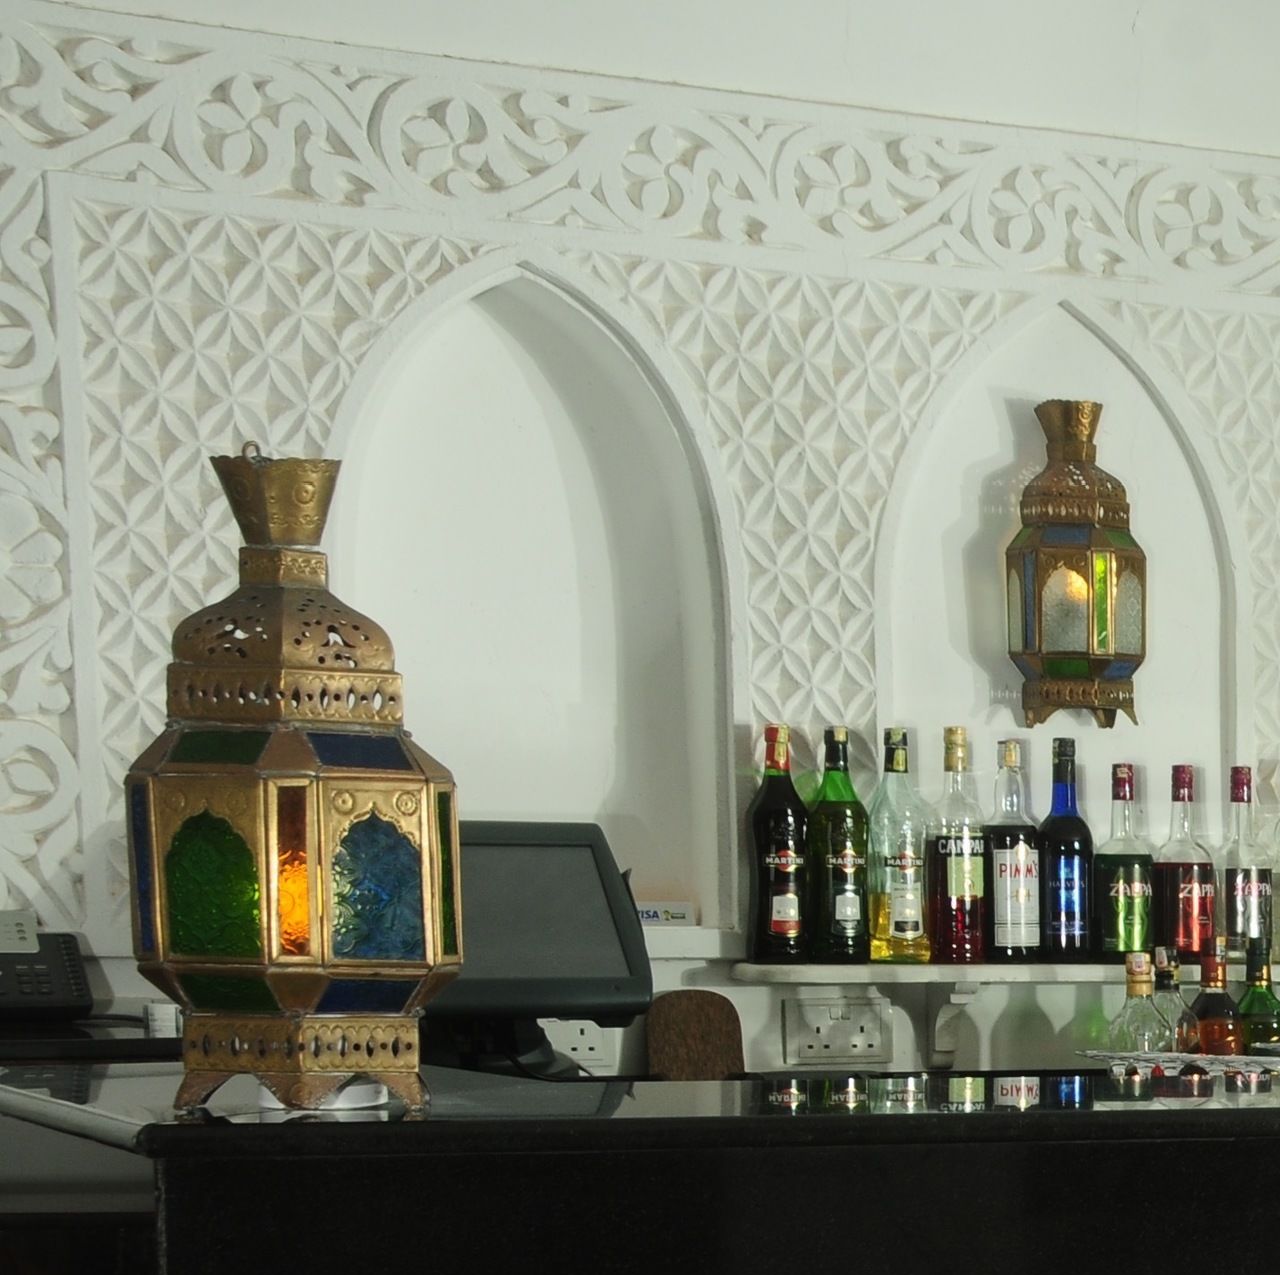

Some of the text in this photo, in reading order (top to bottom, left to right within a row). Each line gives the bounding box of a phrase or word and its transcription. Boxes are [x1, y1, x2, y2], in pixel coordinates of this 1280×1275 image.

[765, 856, 804, 865] MARTINI
[829, 857, 865, 865] MARTINI
[887, 858, 923, 866] MARTINI
[1000, 860, 1037, 878] PIMM'S
